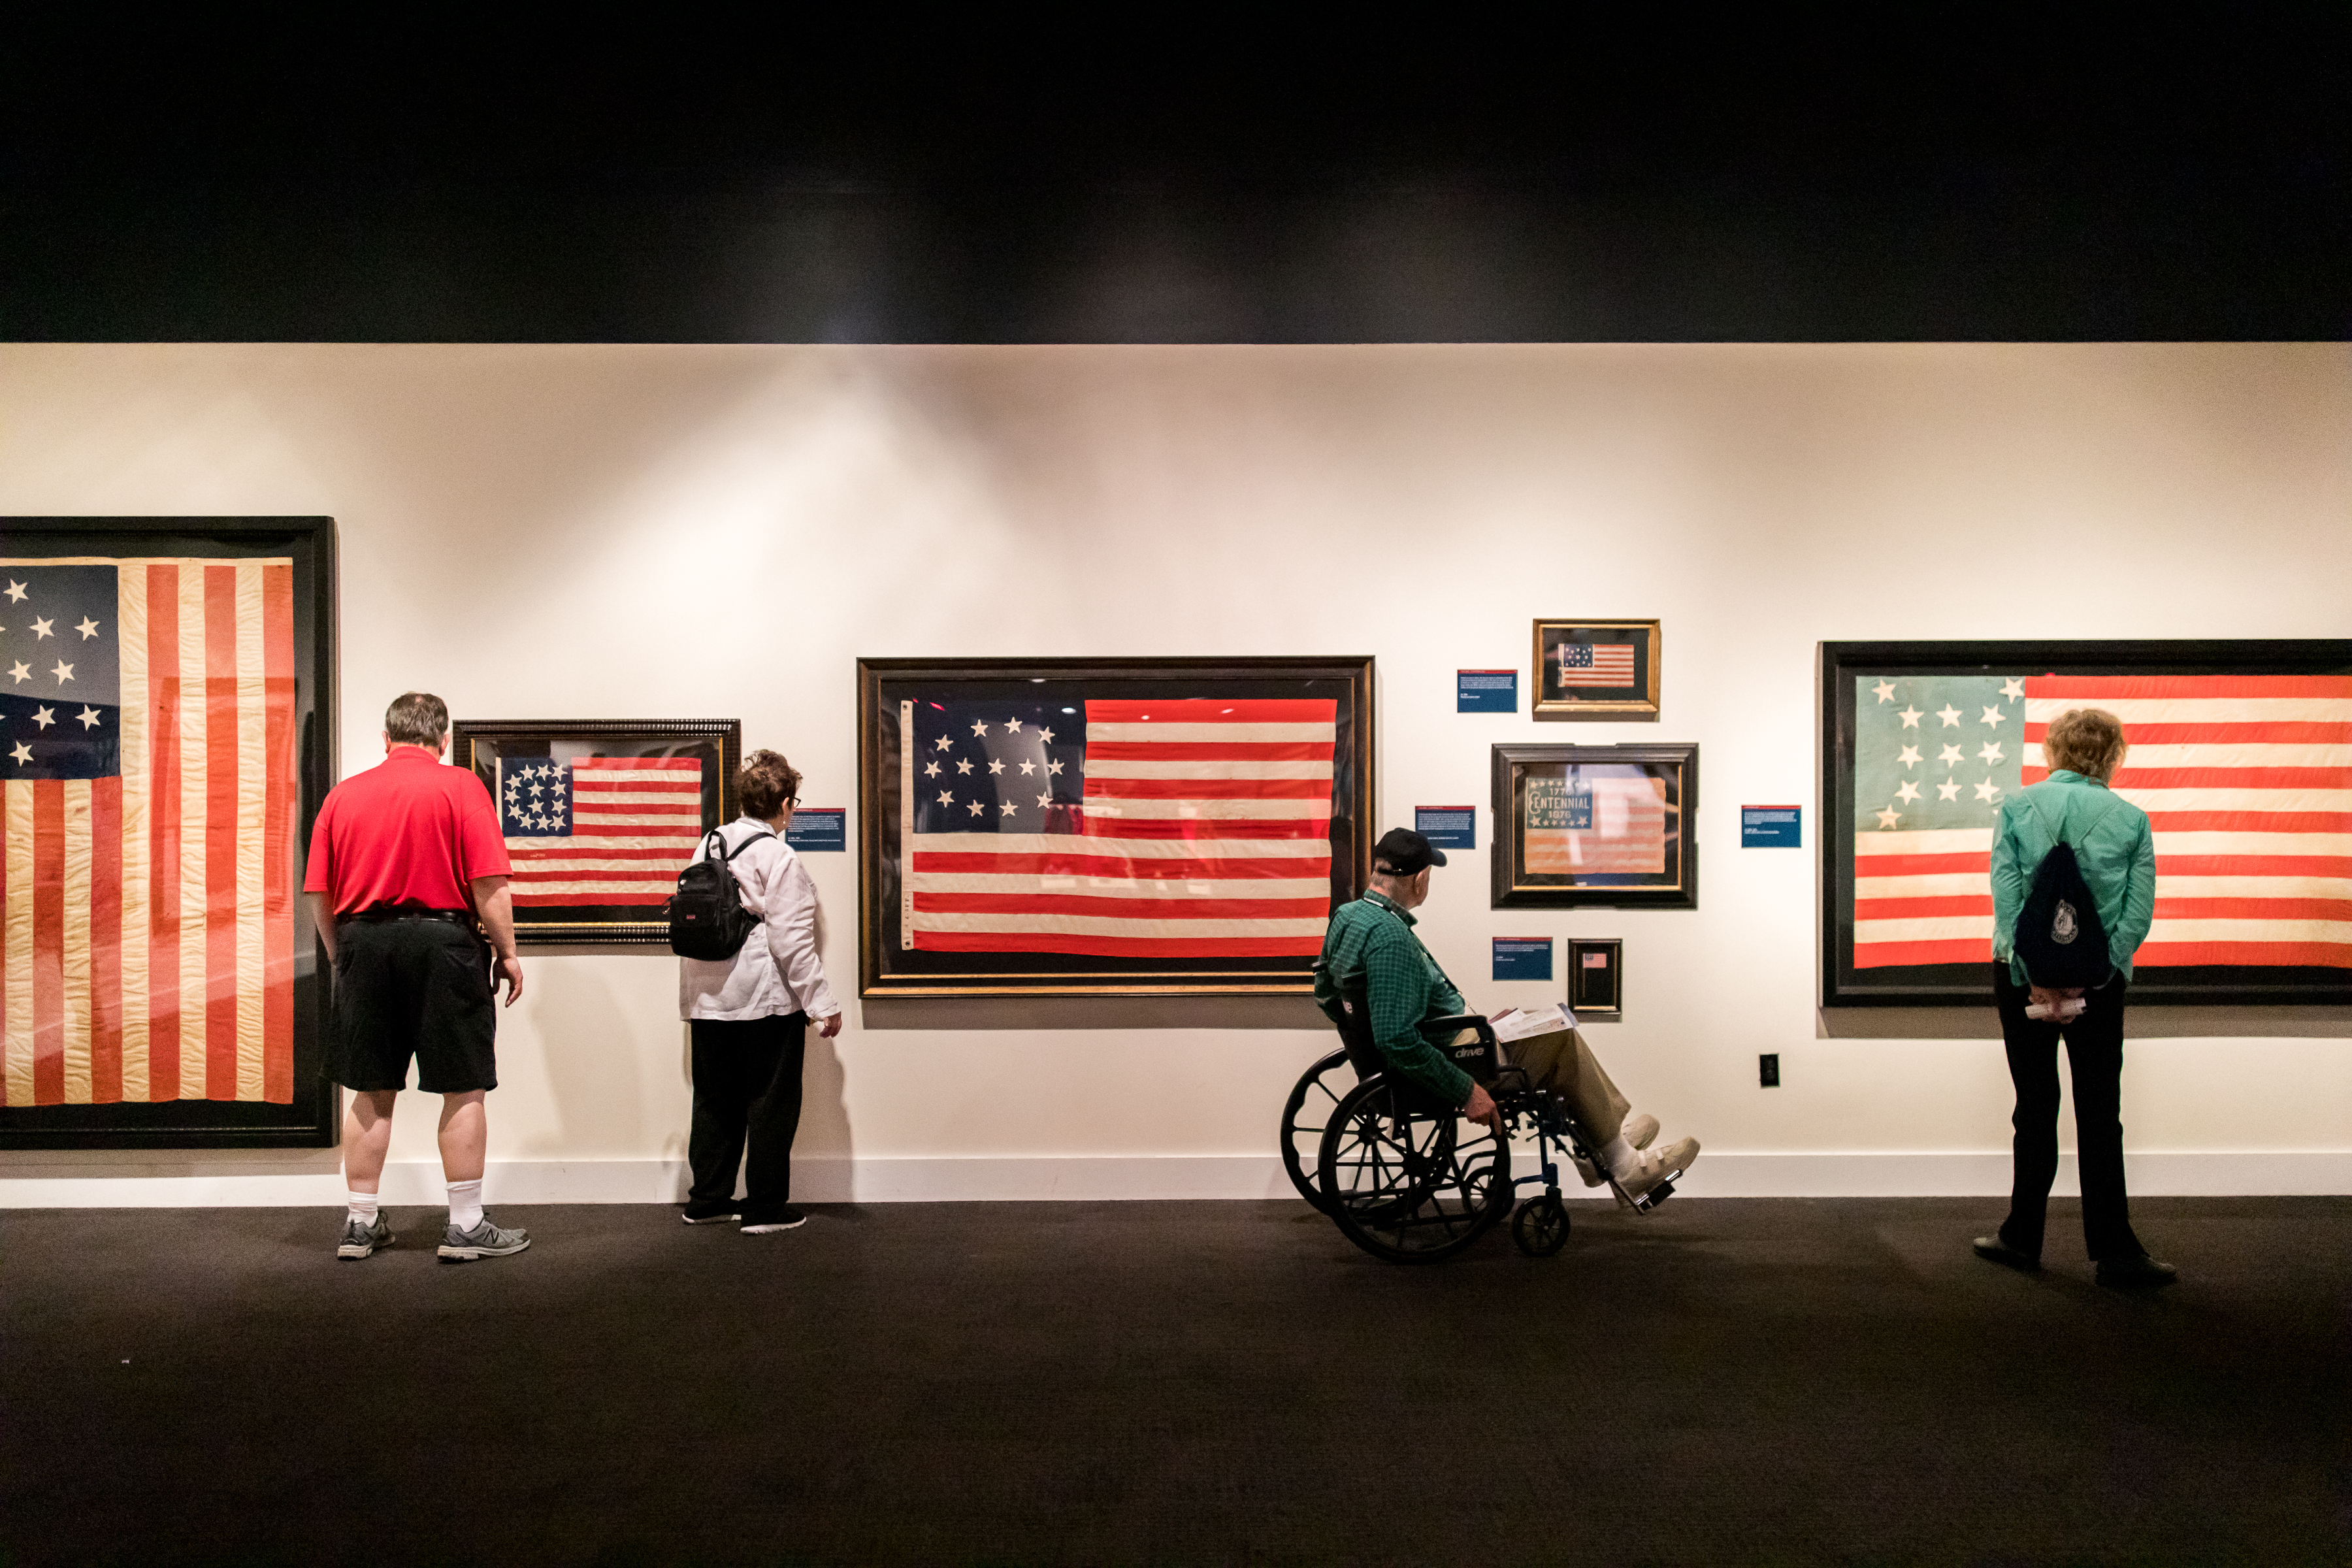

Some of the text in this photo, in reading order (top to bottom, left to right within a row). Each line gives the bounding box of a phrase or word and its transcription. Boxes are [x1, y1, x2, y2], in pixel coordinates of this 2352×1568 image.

[1529, 791, 1590, 814] CENTENNIAL
[1548, 810, 1571, 819] 1876
[1456, 1047, 1484, 1058] drive
